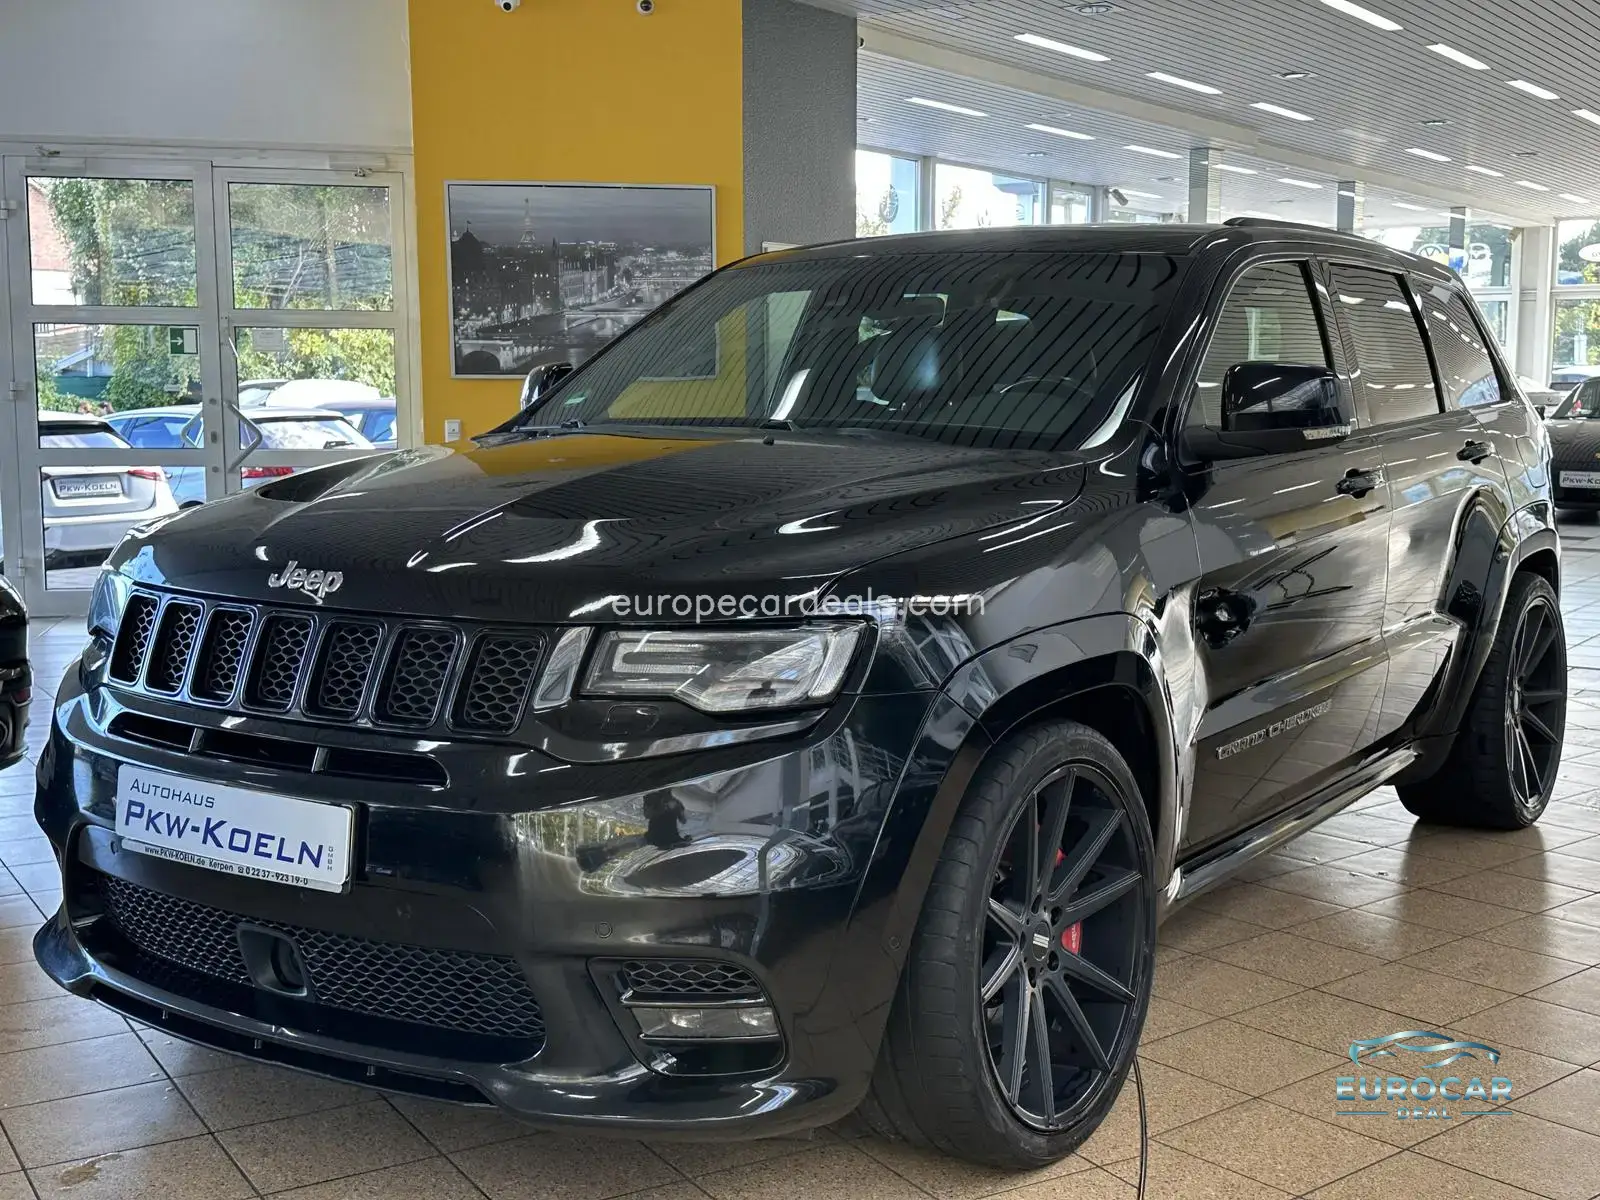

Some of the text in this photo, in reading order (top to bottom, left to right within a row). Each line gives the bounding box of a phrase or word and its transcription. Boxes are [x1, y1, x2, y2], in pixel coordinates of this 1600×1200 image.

[268, 560, 344, 598] Jeep
[130, 778, 215, 808] AUTOHAUS
[124, 799, 324, 868] PKW-KOELN
[144, 845, 206, 866] www.PKW-KOELN.de
[208, 859, 234, 872] Kerpen
